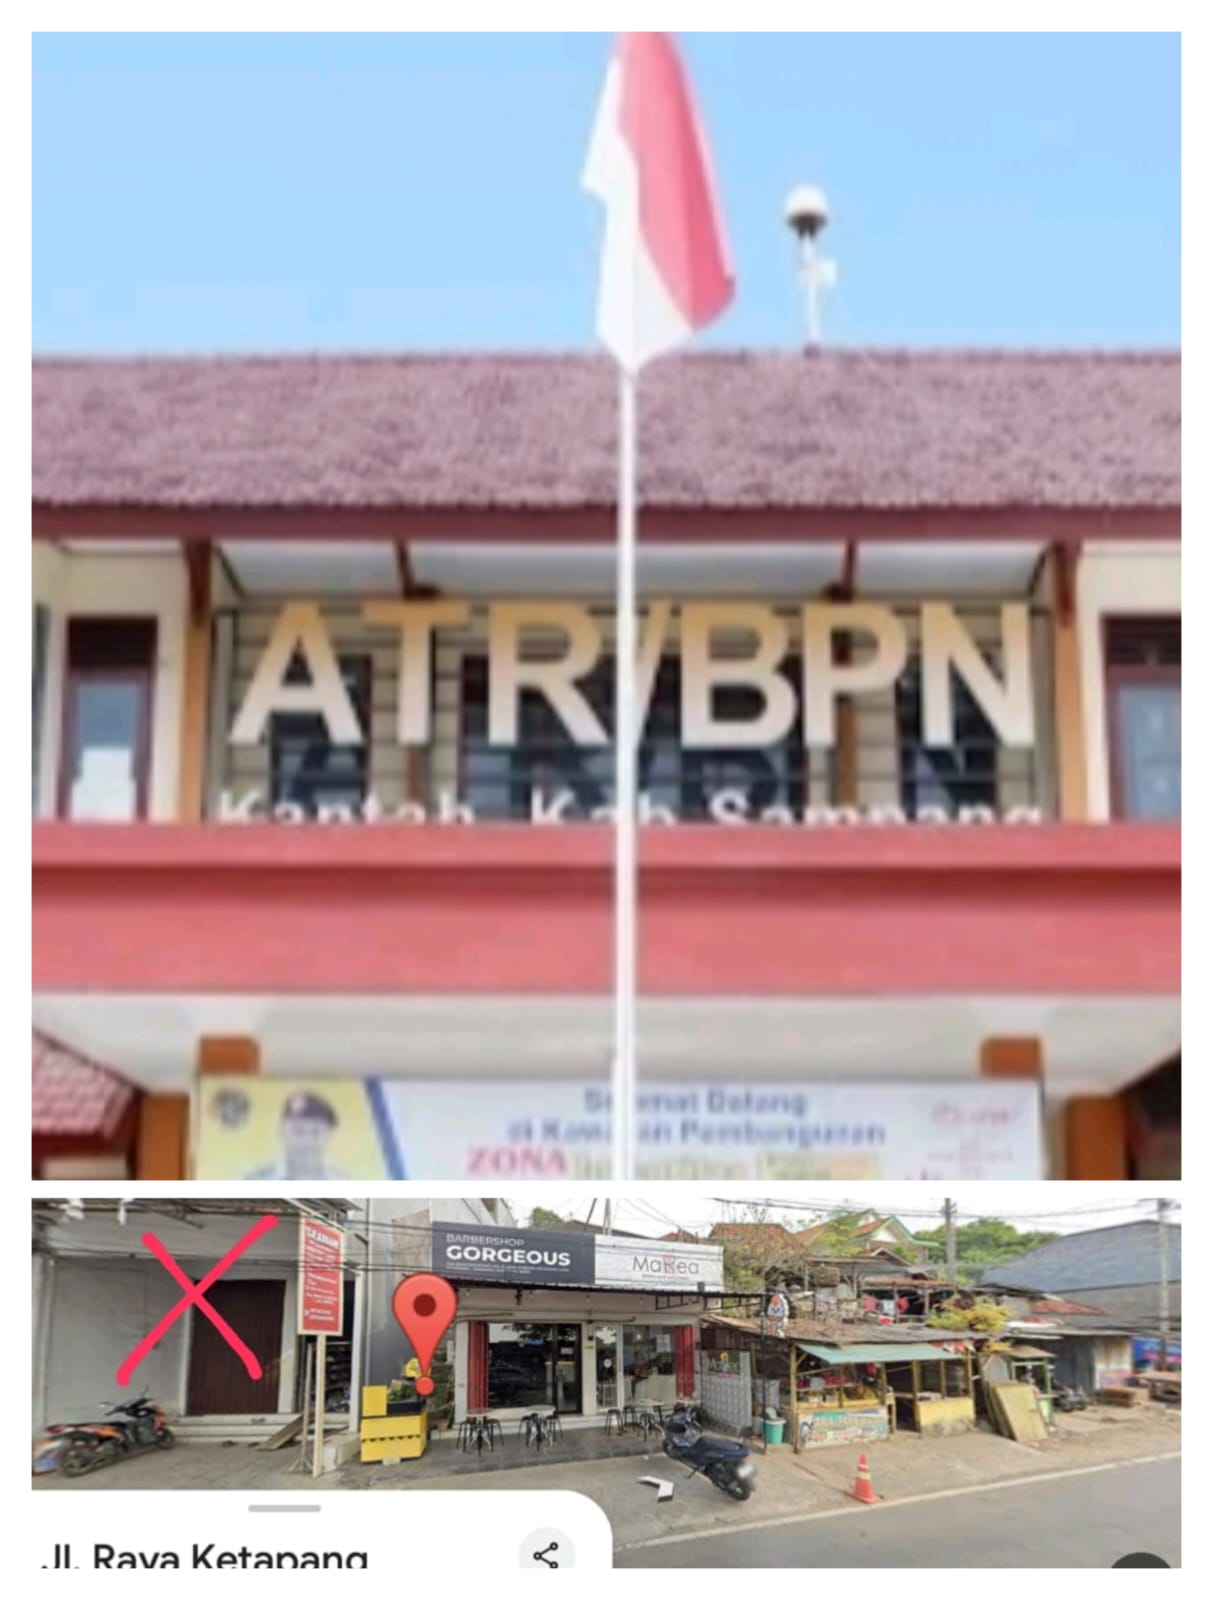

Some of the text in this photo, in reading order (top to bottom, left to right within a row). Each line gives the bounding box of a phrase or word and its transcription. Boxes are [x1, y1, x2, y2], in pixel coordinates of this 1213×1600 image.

[229, 602, 1034, 747] ATR/BPN
[446, 1233, 525, 1248] BARBERSHOP
[446, 1244, 571, 1267] GORGEOUS
